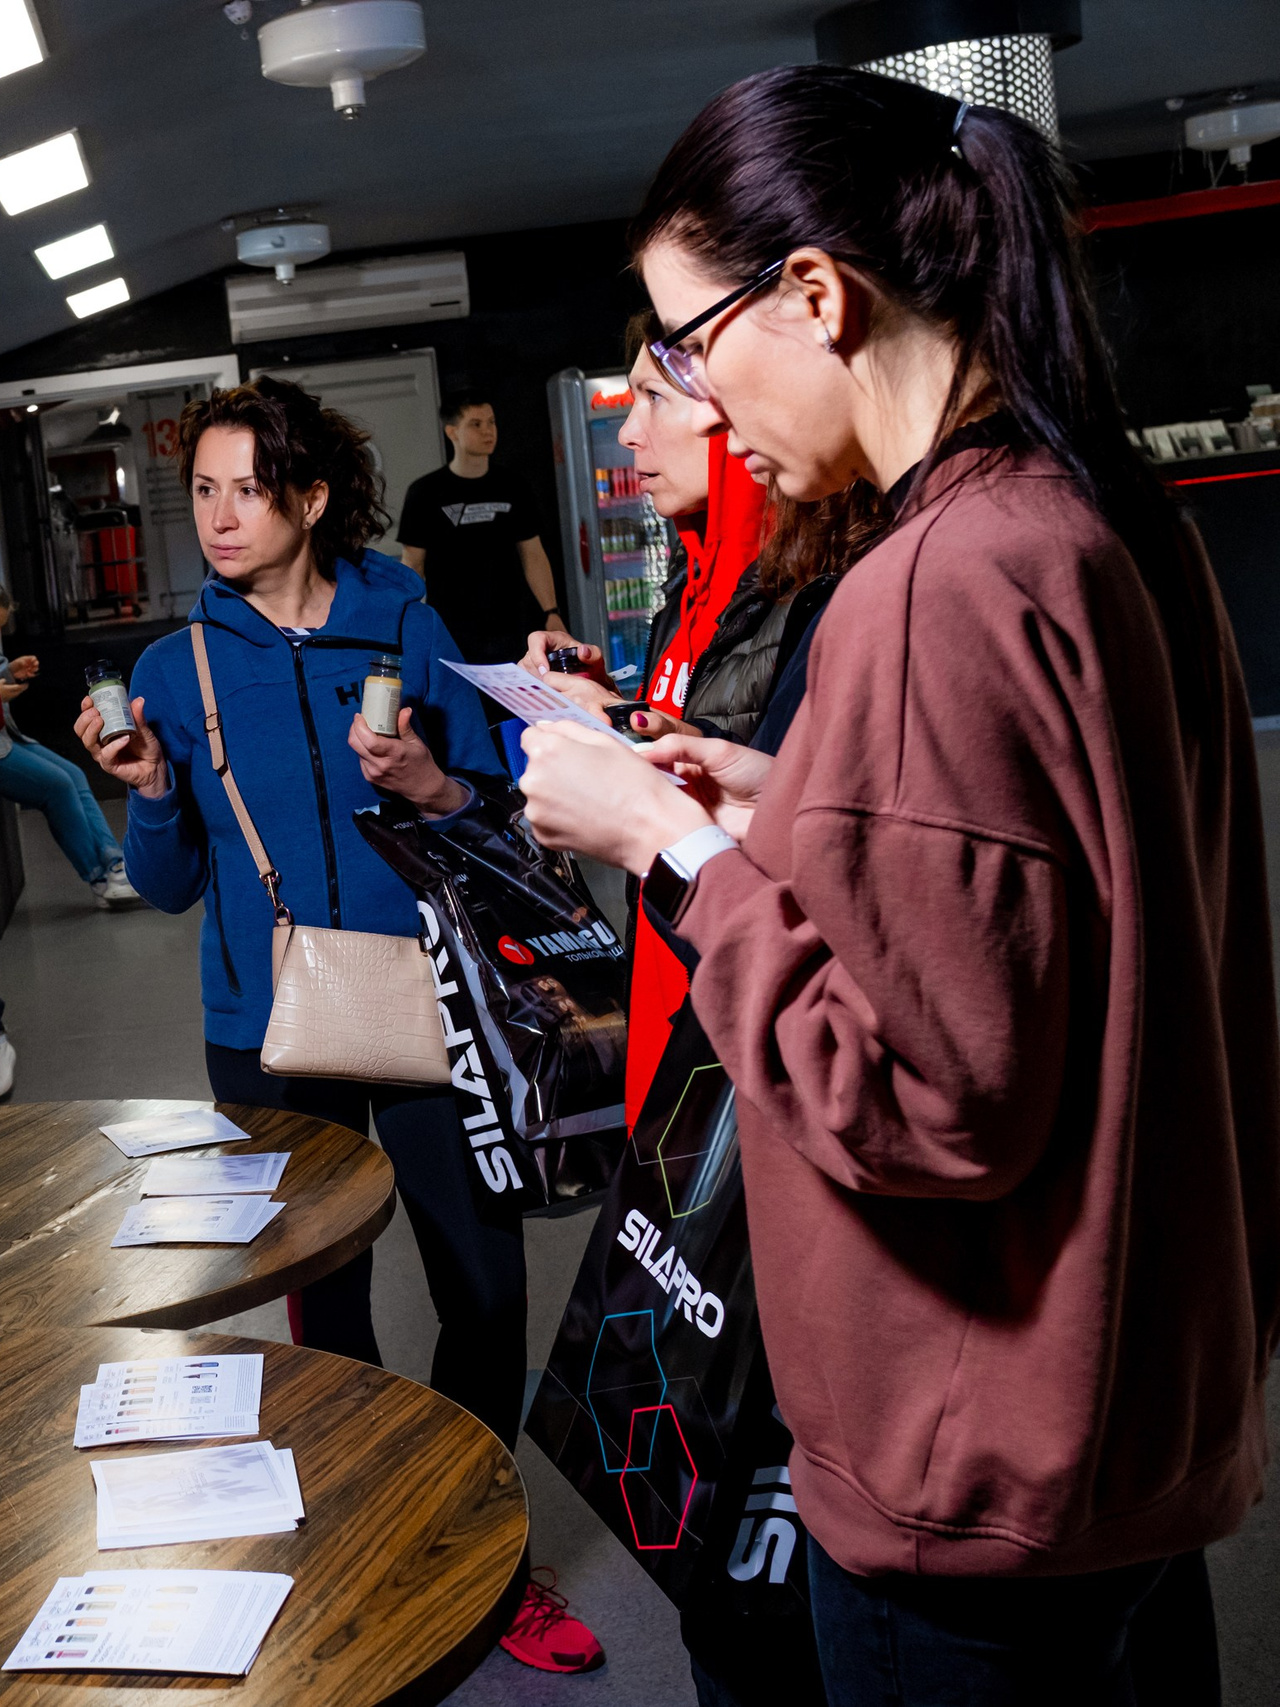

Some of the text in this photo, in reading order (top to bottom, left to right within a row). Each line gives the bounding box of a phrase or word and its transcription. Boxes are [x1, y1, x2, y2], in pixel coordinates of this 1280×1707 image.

[142, 418, 179, 458] 13
[334, 678, 373, 707] H
[616, 1208, 726, 1339] SILAPRO
